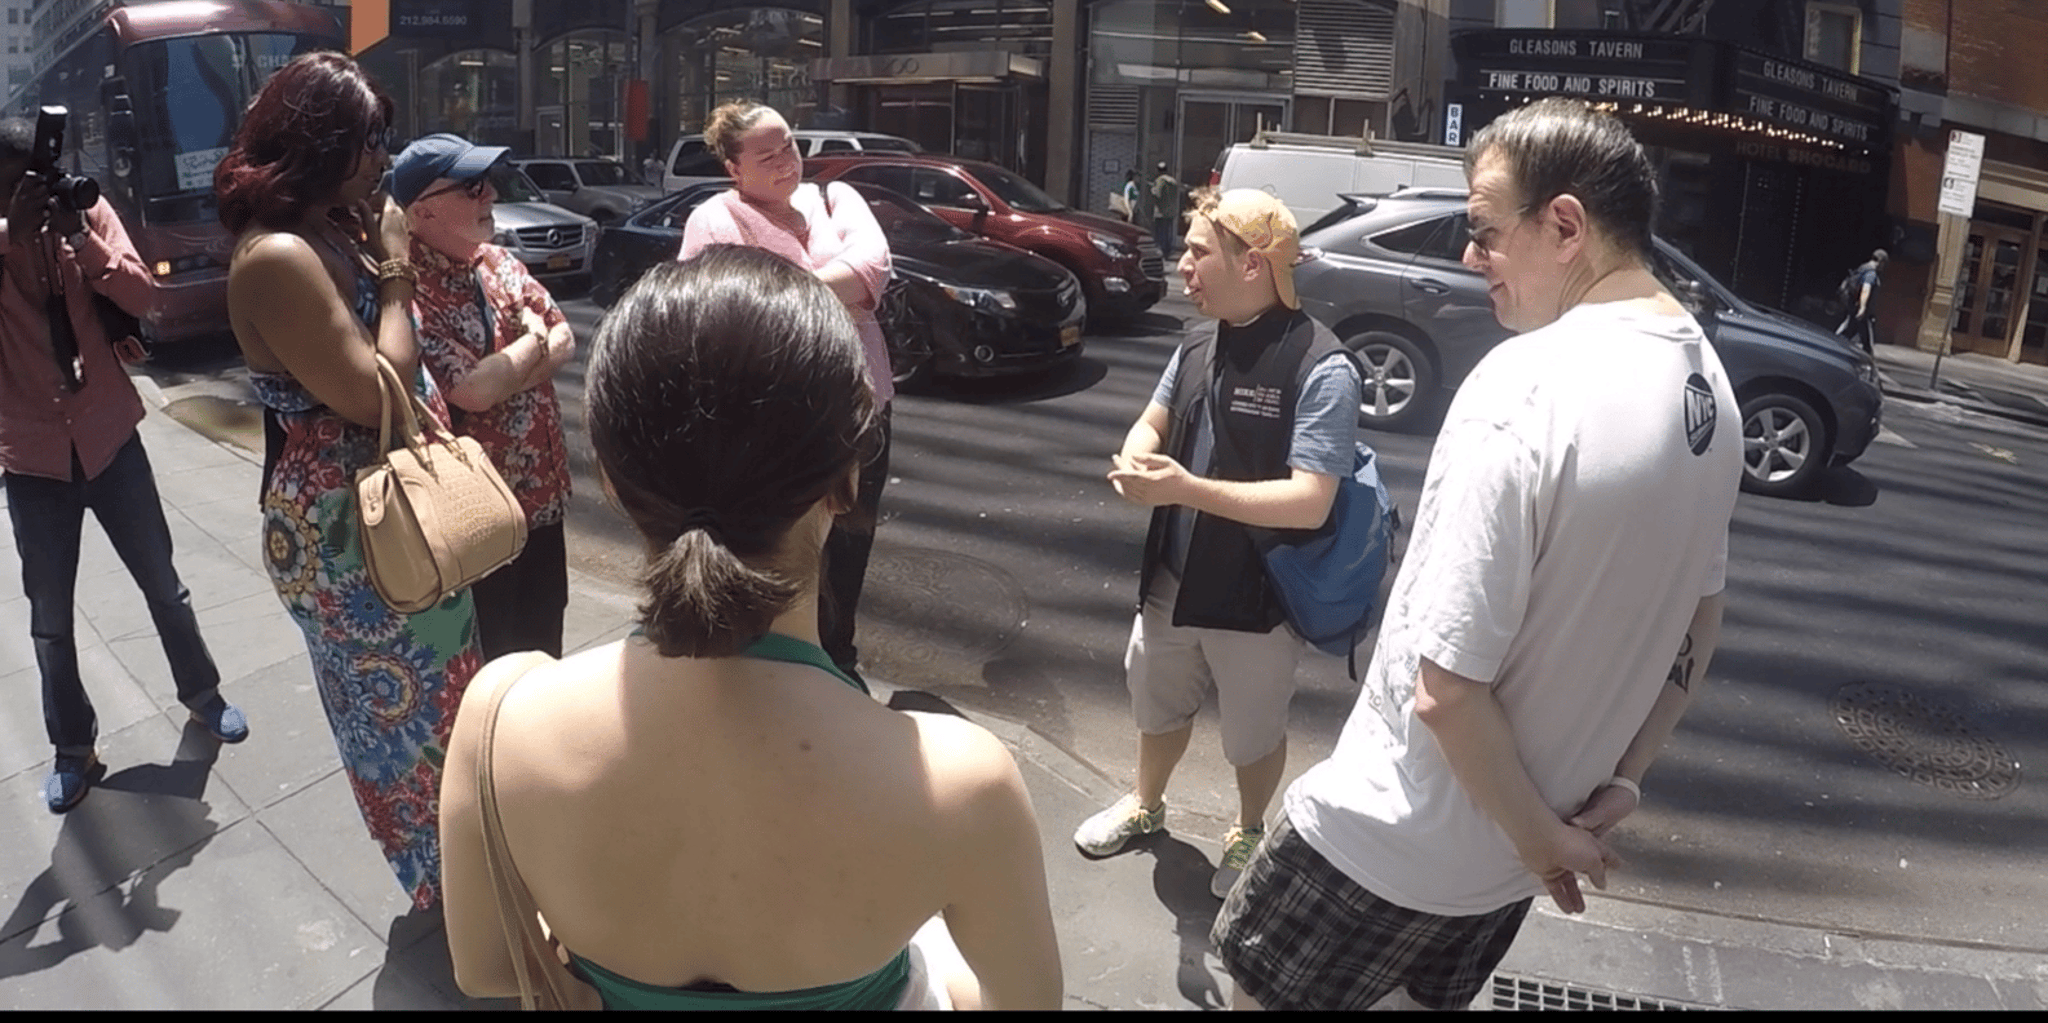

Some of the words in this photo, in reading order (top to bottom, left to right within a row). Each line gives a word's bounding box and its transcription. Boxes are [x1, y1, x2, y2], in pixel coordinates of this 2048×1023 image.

[1510, 39, 1577, 56] GLEASONS
[1589, 41, 1643, 58] TAVERN
[1489, 73, 1518, 89] FINE
[1525, 75, 1559, 91] FOOD
[1563, 77, 1591, 92] AND
[1598, 79, 1655, 97] SPIRITS
[1763, 60, 1815, 89] GLEASONS
[1822, 78, 1858, 101] TAVERN
[1449, 106, 1459, 142] BAR
[1749, 96, 1774, 117] FINE
[1779, 101, 1806, 124] FOOD
[1809, 112, 1828, 131] AND
[1831, 118, 1868, 141] SPIRITS
[1735, 141, 1782, 161] HOTEL
[1685, 388, 1716, 435] NYC
